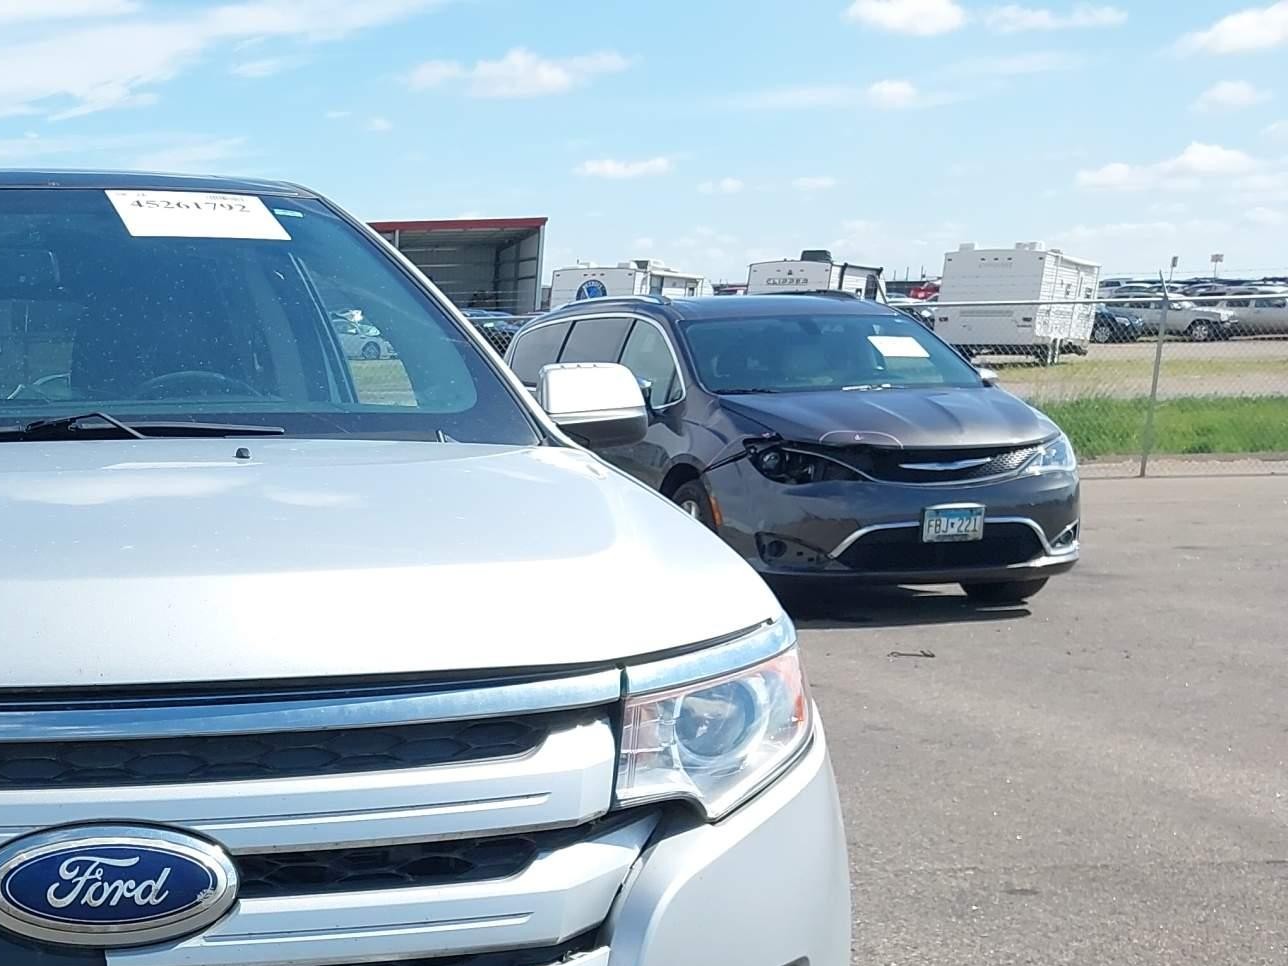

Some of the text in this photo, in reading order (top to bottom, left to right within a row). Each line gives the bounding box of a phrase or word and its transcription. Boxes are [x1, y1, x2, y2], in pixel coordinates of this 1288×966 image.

[131, 200, 251, 213] 45261792
[927, 517, 978, 534] FBJ 221
[46, 856, 171, 908] Ford
